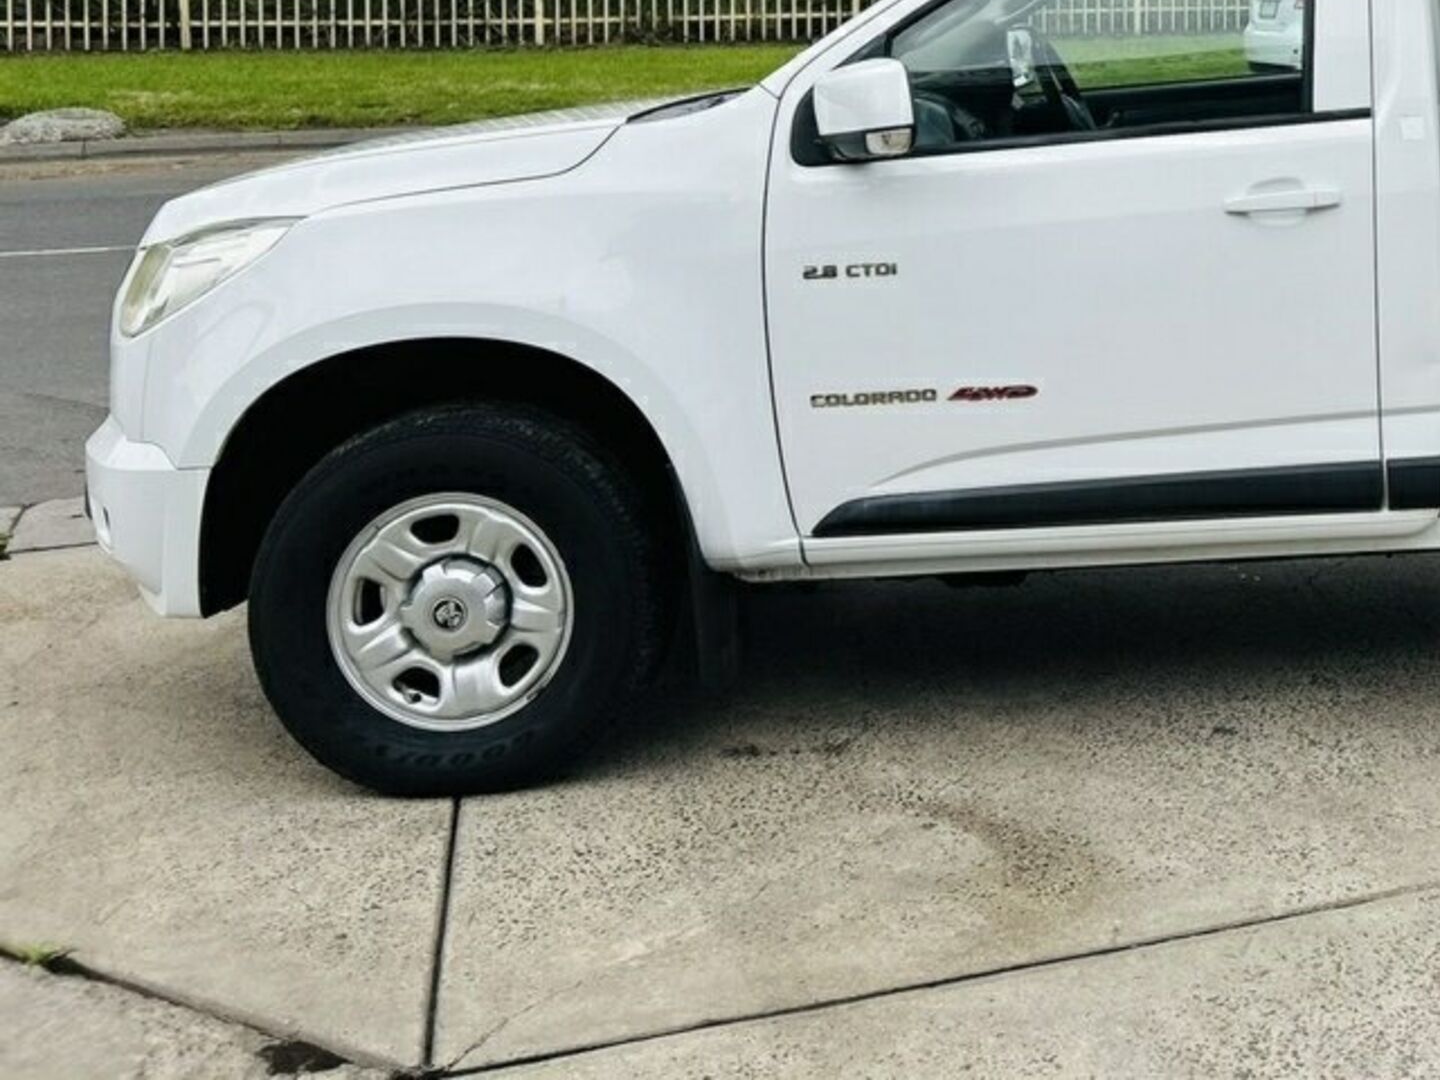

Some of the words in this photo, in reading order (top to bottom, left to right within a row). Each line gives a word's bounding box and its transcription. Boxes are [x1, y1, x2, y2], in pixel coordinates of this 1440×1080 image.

[803, 265, 838, 280] 2.8
[810, 388, 938, 409] COLORADO
[946, 384, 1039, 402] 4WD
